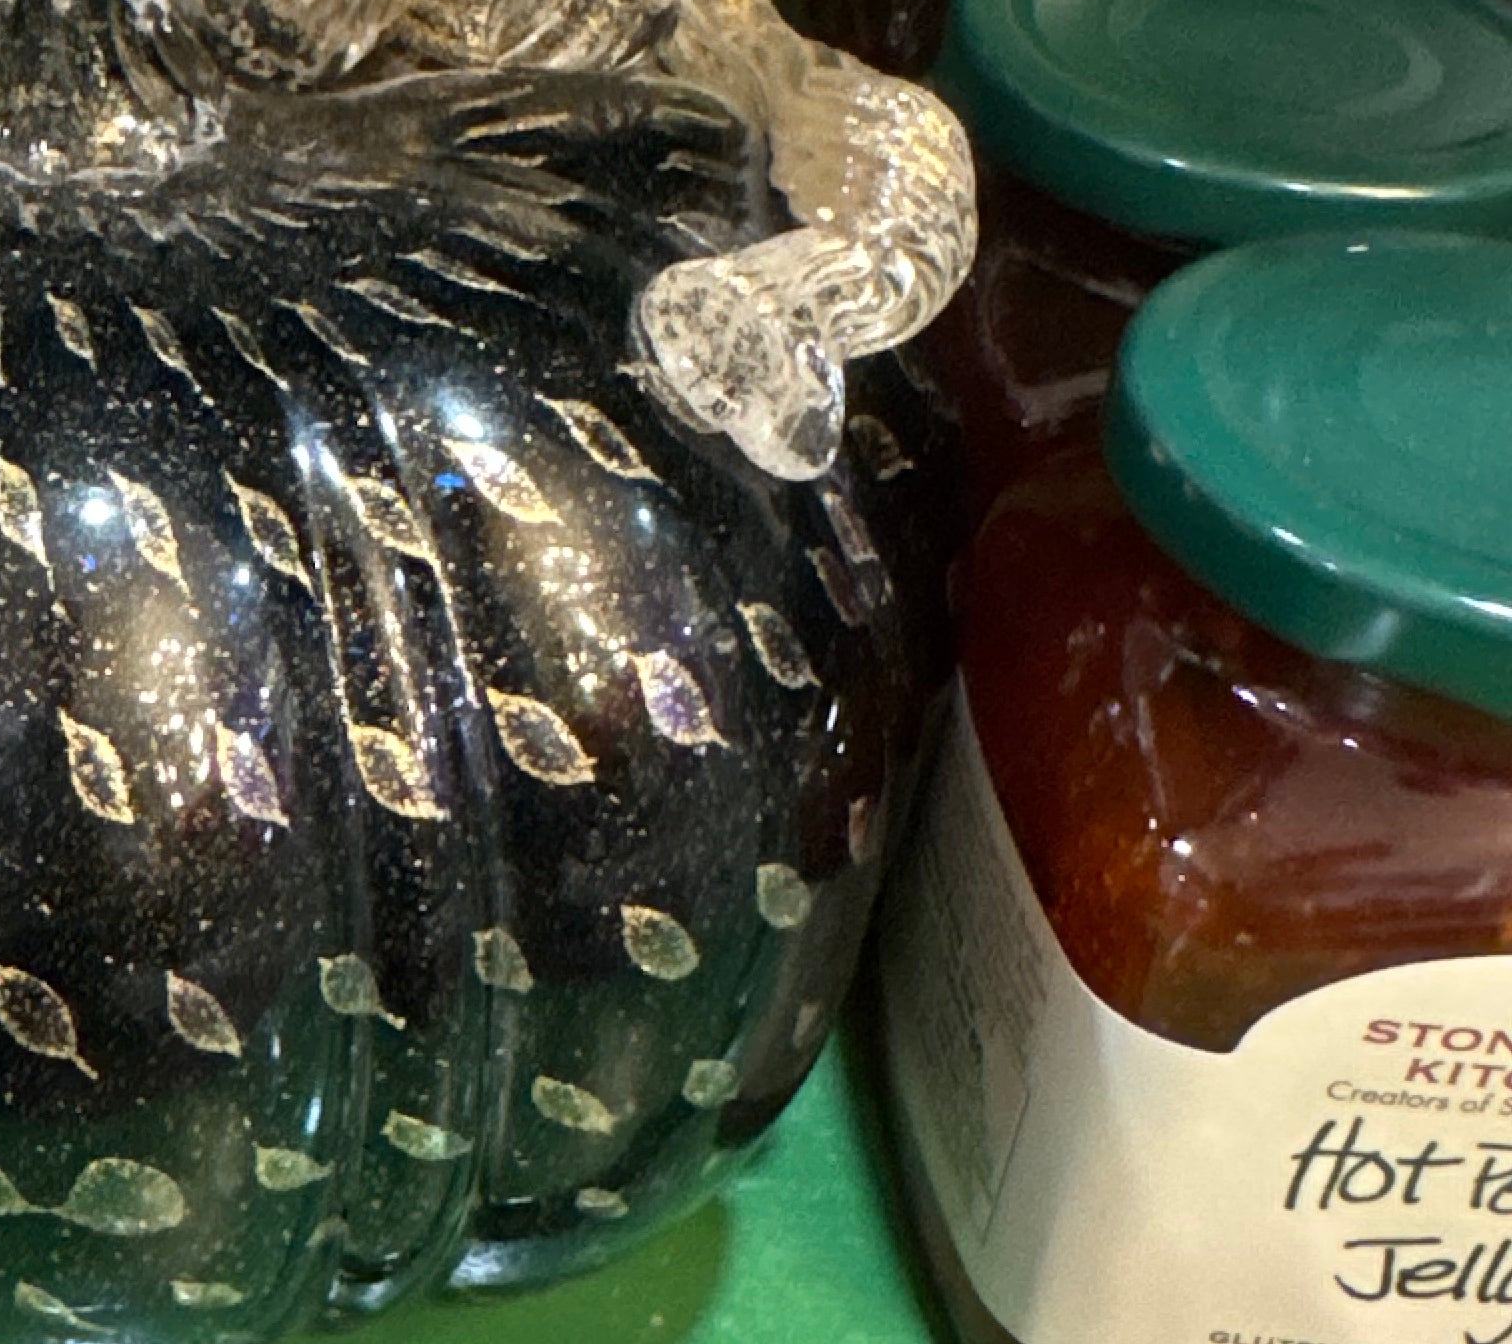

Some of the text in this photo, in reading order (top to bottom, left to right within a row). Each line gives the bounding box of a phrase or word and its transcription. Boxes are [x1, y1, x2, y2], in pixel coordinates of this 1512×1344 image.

[1325, 1079, 1450, 1112] Creators
[1459, 1092, 1496, 1114] of
[1283, 1115, 1466, 1211] Hot
